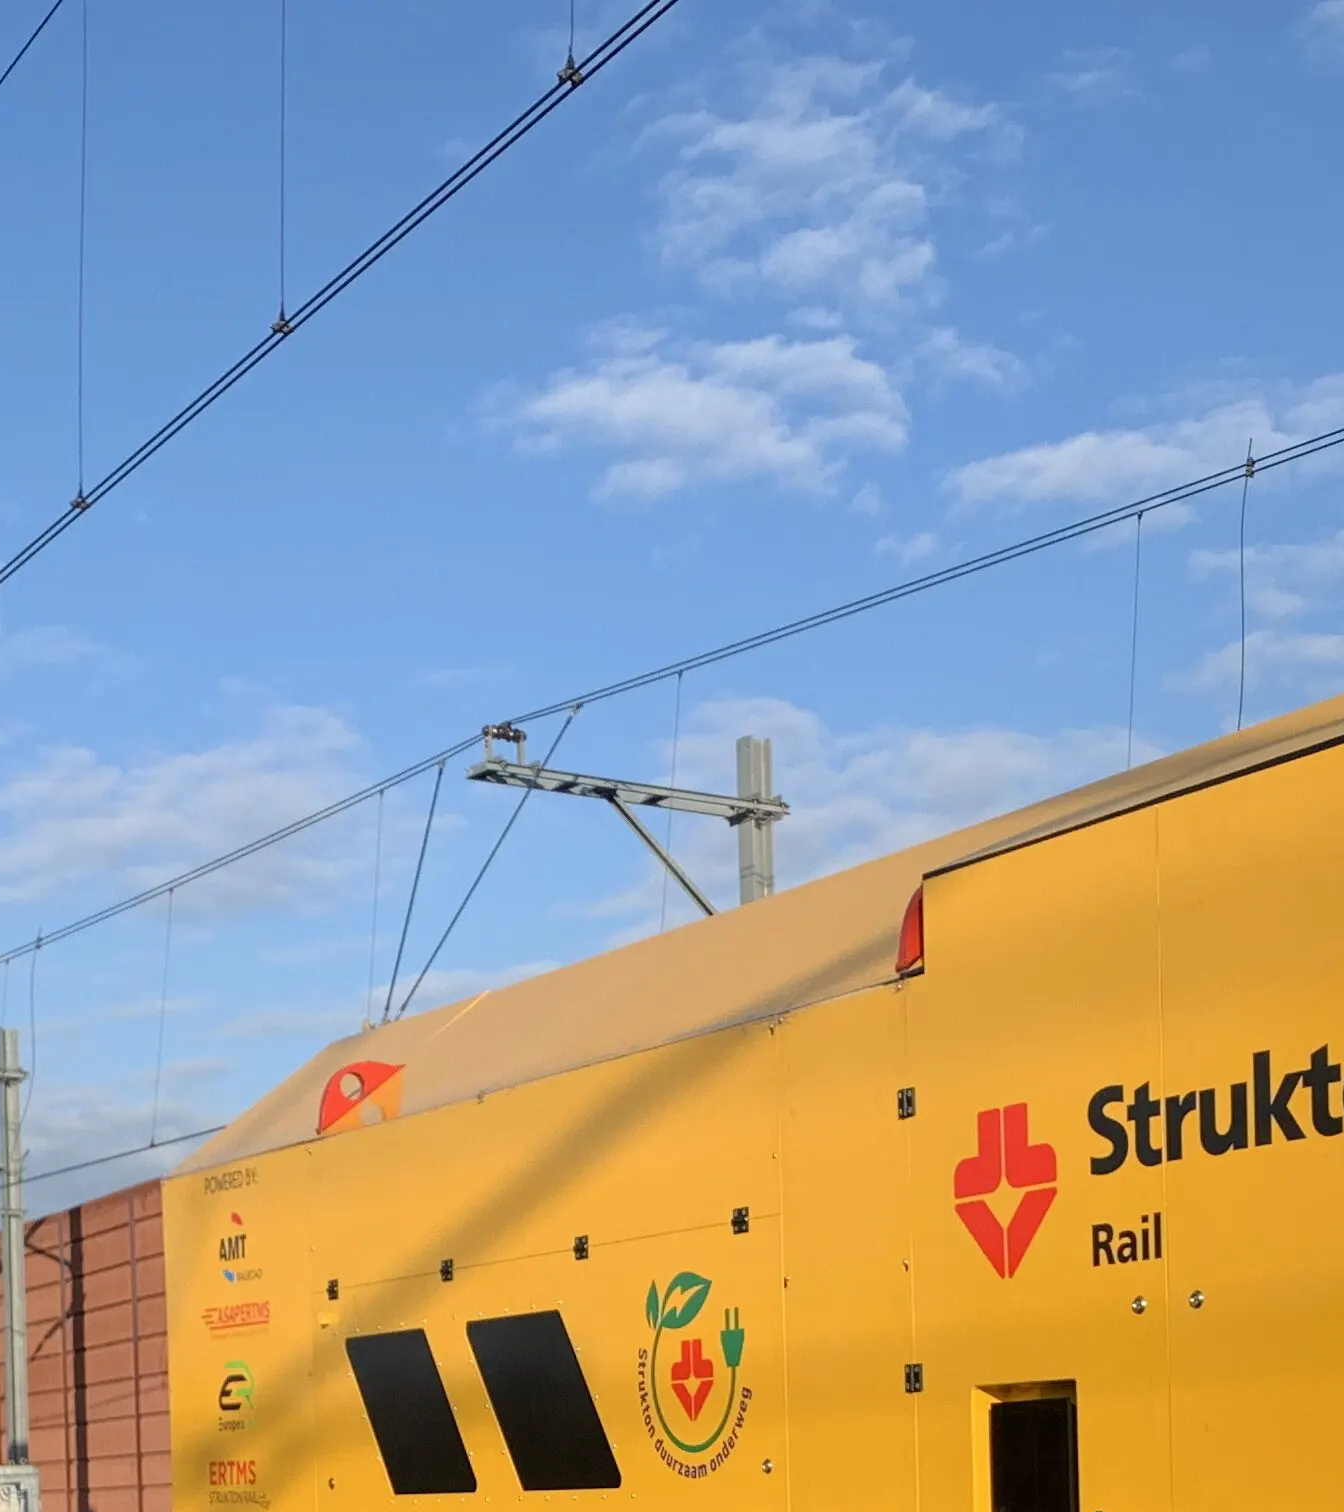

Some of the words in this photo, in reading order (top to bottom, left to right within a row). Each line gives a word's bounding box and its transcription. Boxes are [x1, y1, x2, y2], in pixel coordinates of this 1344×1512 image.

[204, 1169, 244, 1195] POWERED
[219, 1234, 247, 1262] AMT
[1091, 1211, 1163, 1267] Rail
[638, 1348, 656, 1439] Strukton
[654, 1438, 709, 1480] duurzaam
[710, 1385, 753, 1472] onderweg
[209, 1460, 257, 1487] ERTMS
